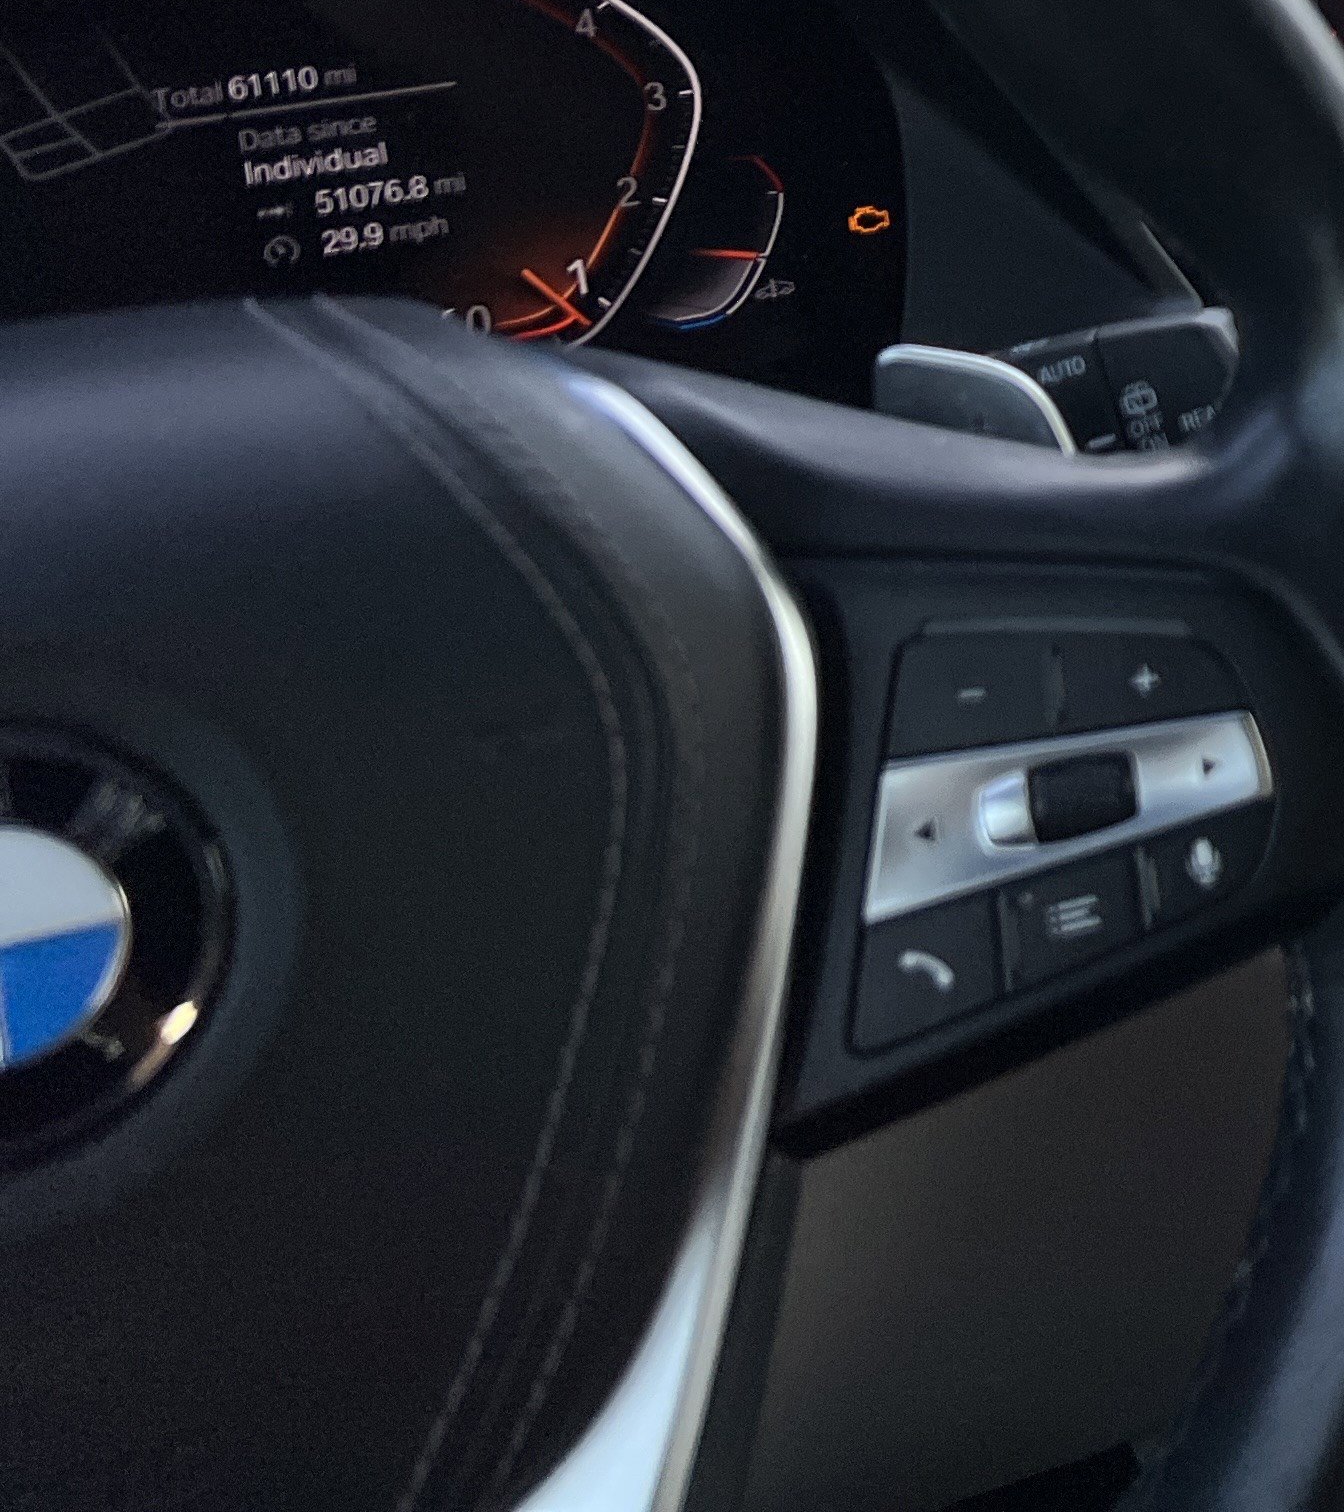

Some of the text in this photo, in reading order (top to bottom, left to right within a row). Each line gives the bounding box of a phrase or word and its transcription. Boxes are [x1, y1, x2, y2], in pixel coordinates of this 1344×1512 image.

[575, 8, 598, 38] 4
[154, 64, 357, 114] Total 61110 mi
[643, 82, 668, 111] 3
[238, 114, 377, 152] Data since
[243, 141, 388, 186] Individual
[314, 175, 430, 216] 51076.8
[616, 176, 641, 208] 2
[321, 221, 385, 257] 29.9
[566, 258, 590, 296] 1
[1038, 355, 1087, 383] AUTO
